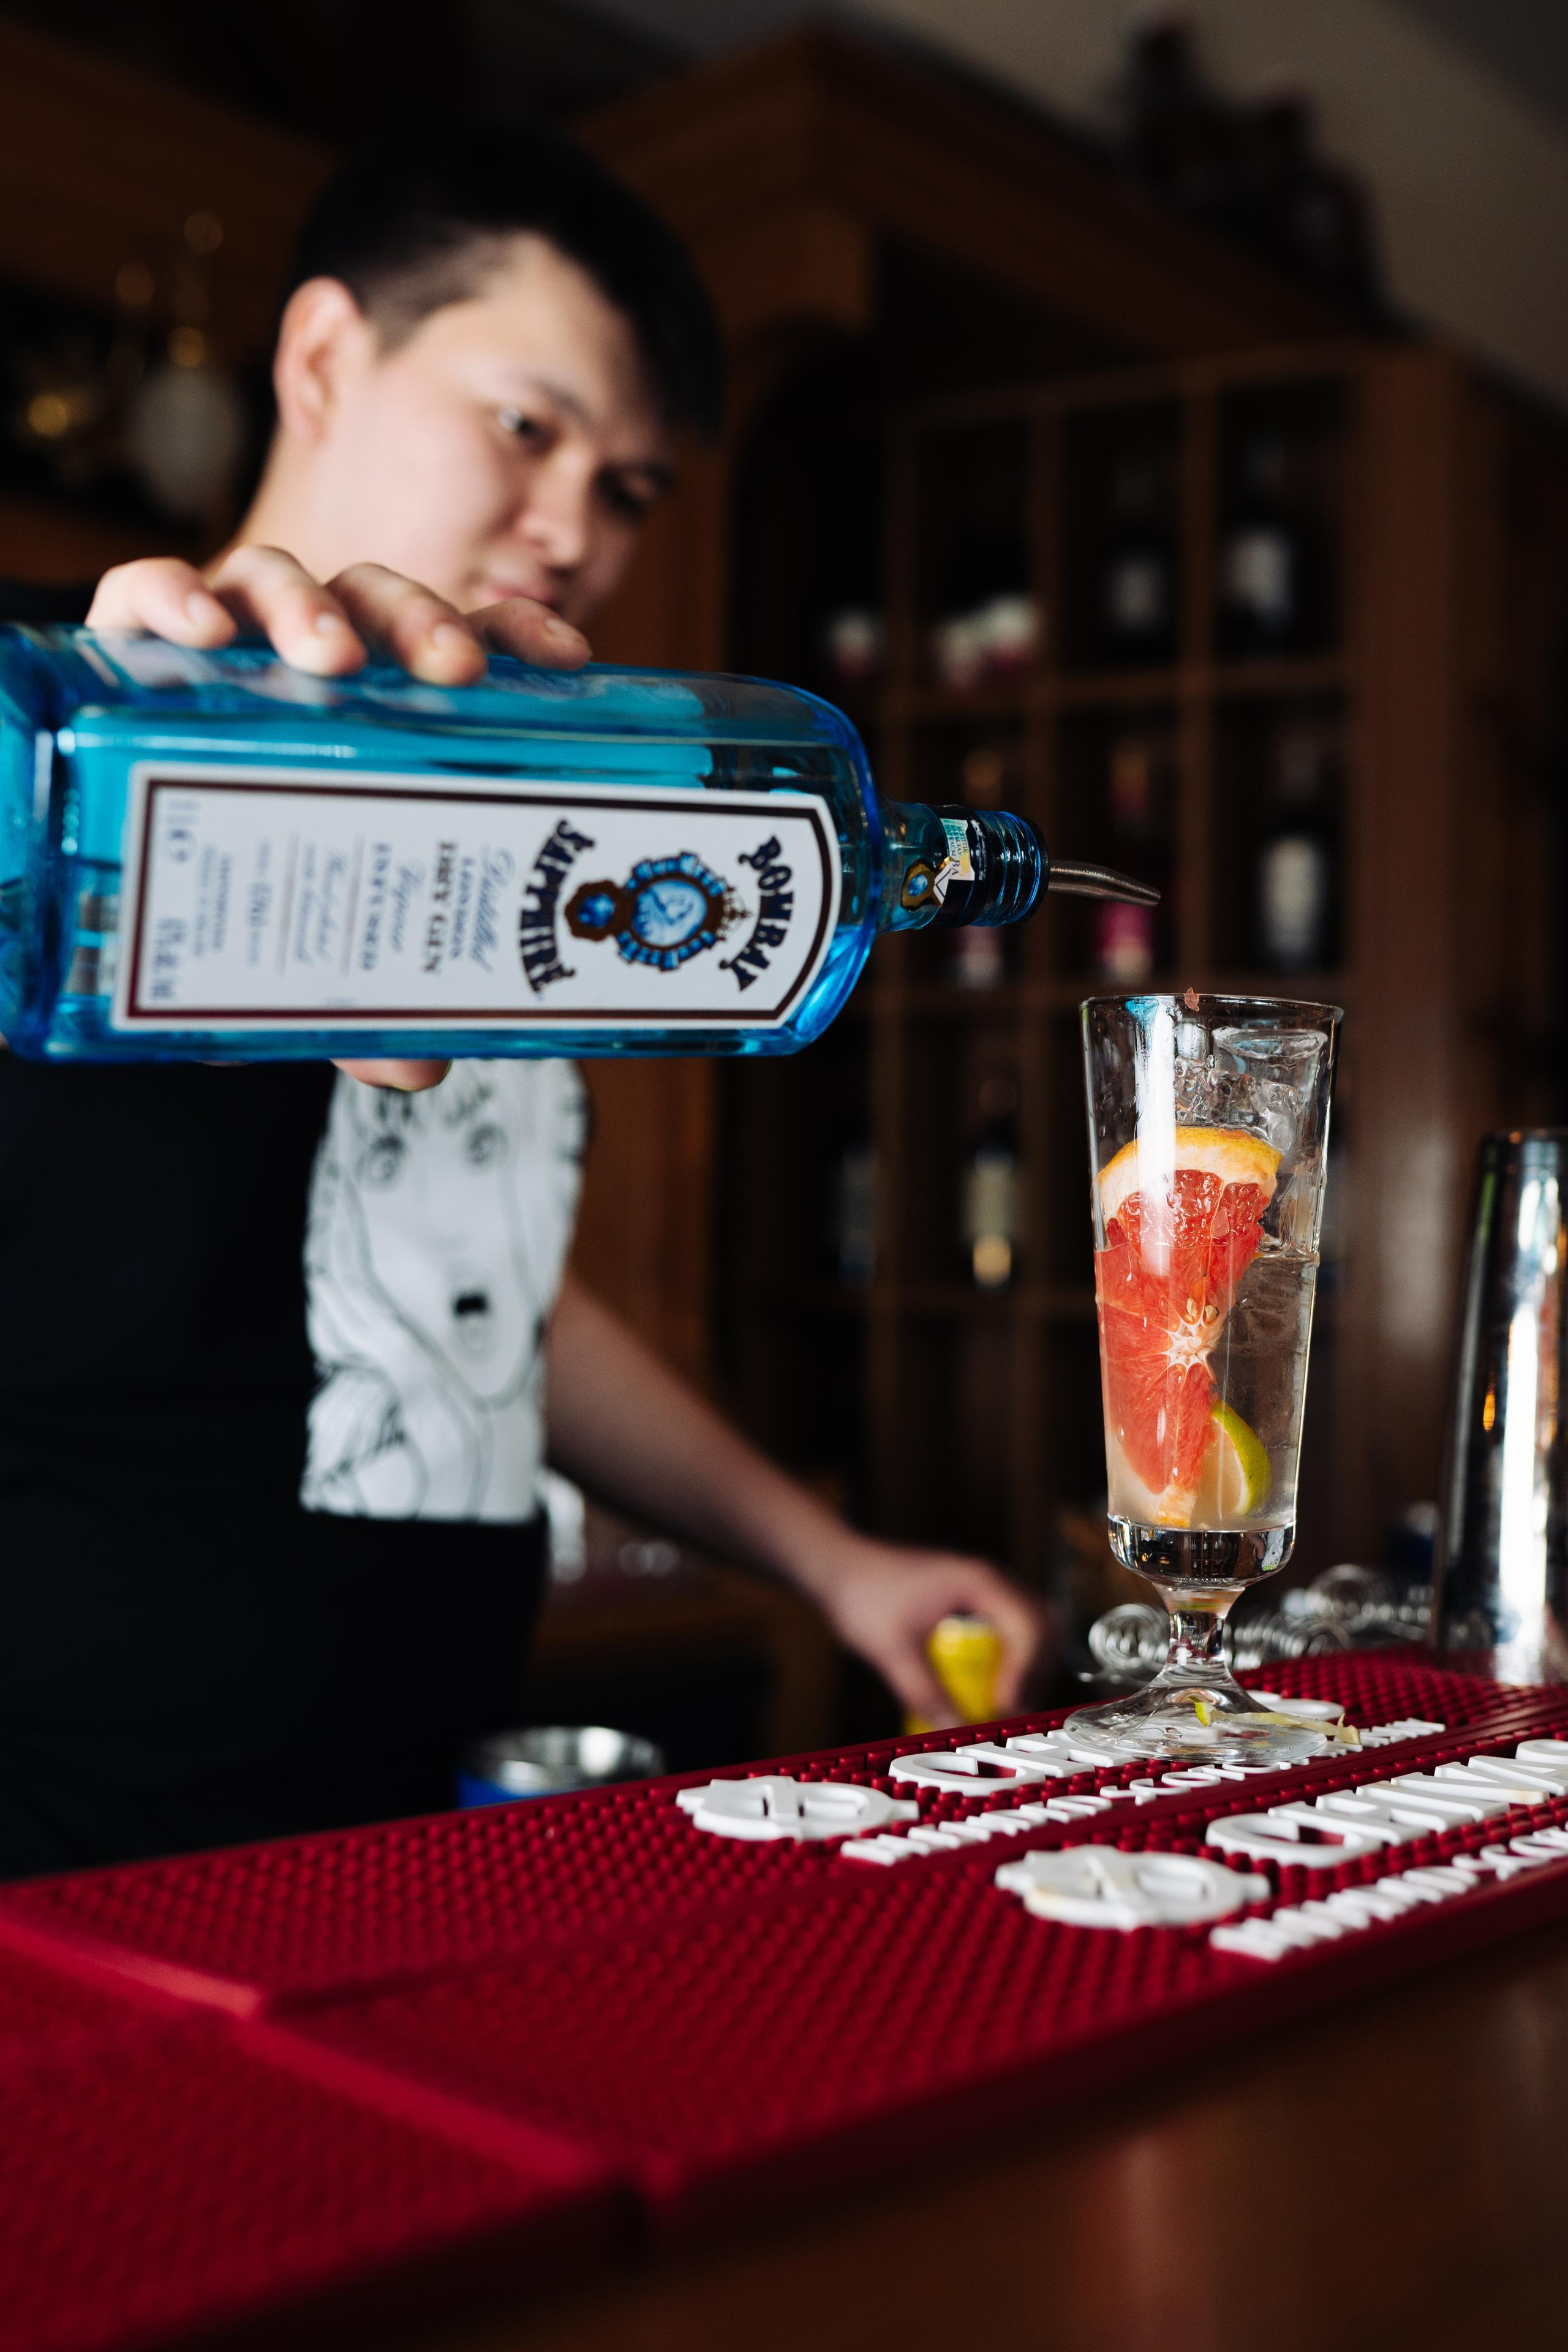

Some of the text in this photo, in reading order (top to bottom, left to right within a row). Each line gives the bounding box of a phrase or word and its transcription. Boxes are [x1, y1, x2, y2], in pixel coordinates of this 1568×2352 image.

[422, 840, 458, 974] DRY GIN
[518, 818, 595, 993] SAPPHIRE
[718, 835, 794, 992] BOMBAY
